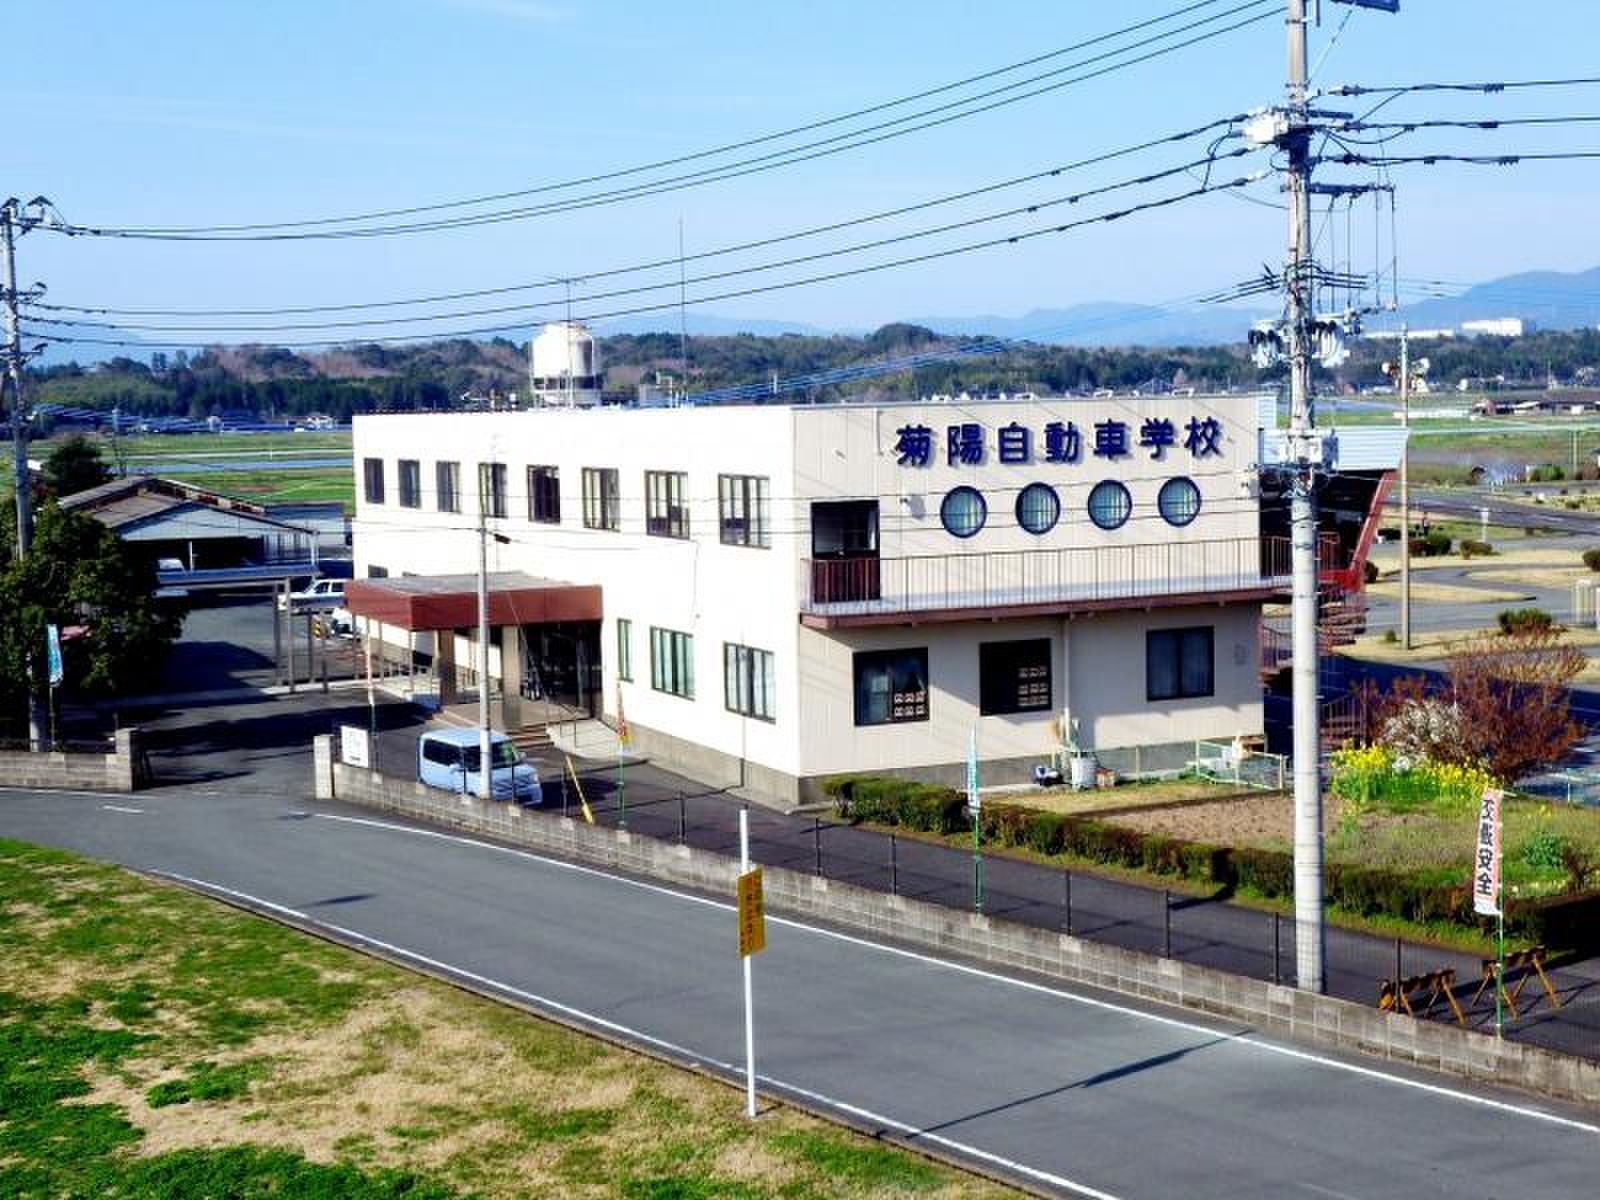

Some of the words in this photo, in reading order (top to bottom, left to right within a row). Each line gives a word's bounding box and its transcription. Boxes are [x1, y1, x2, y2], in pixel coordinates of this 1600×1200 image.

[895, 415, 1222, 467] 菊陽自動車学校
